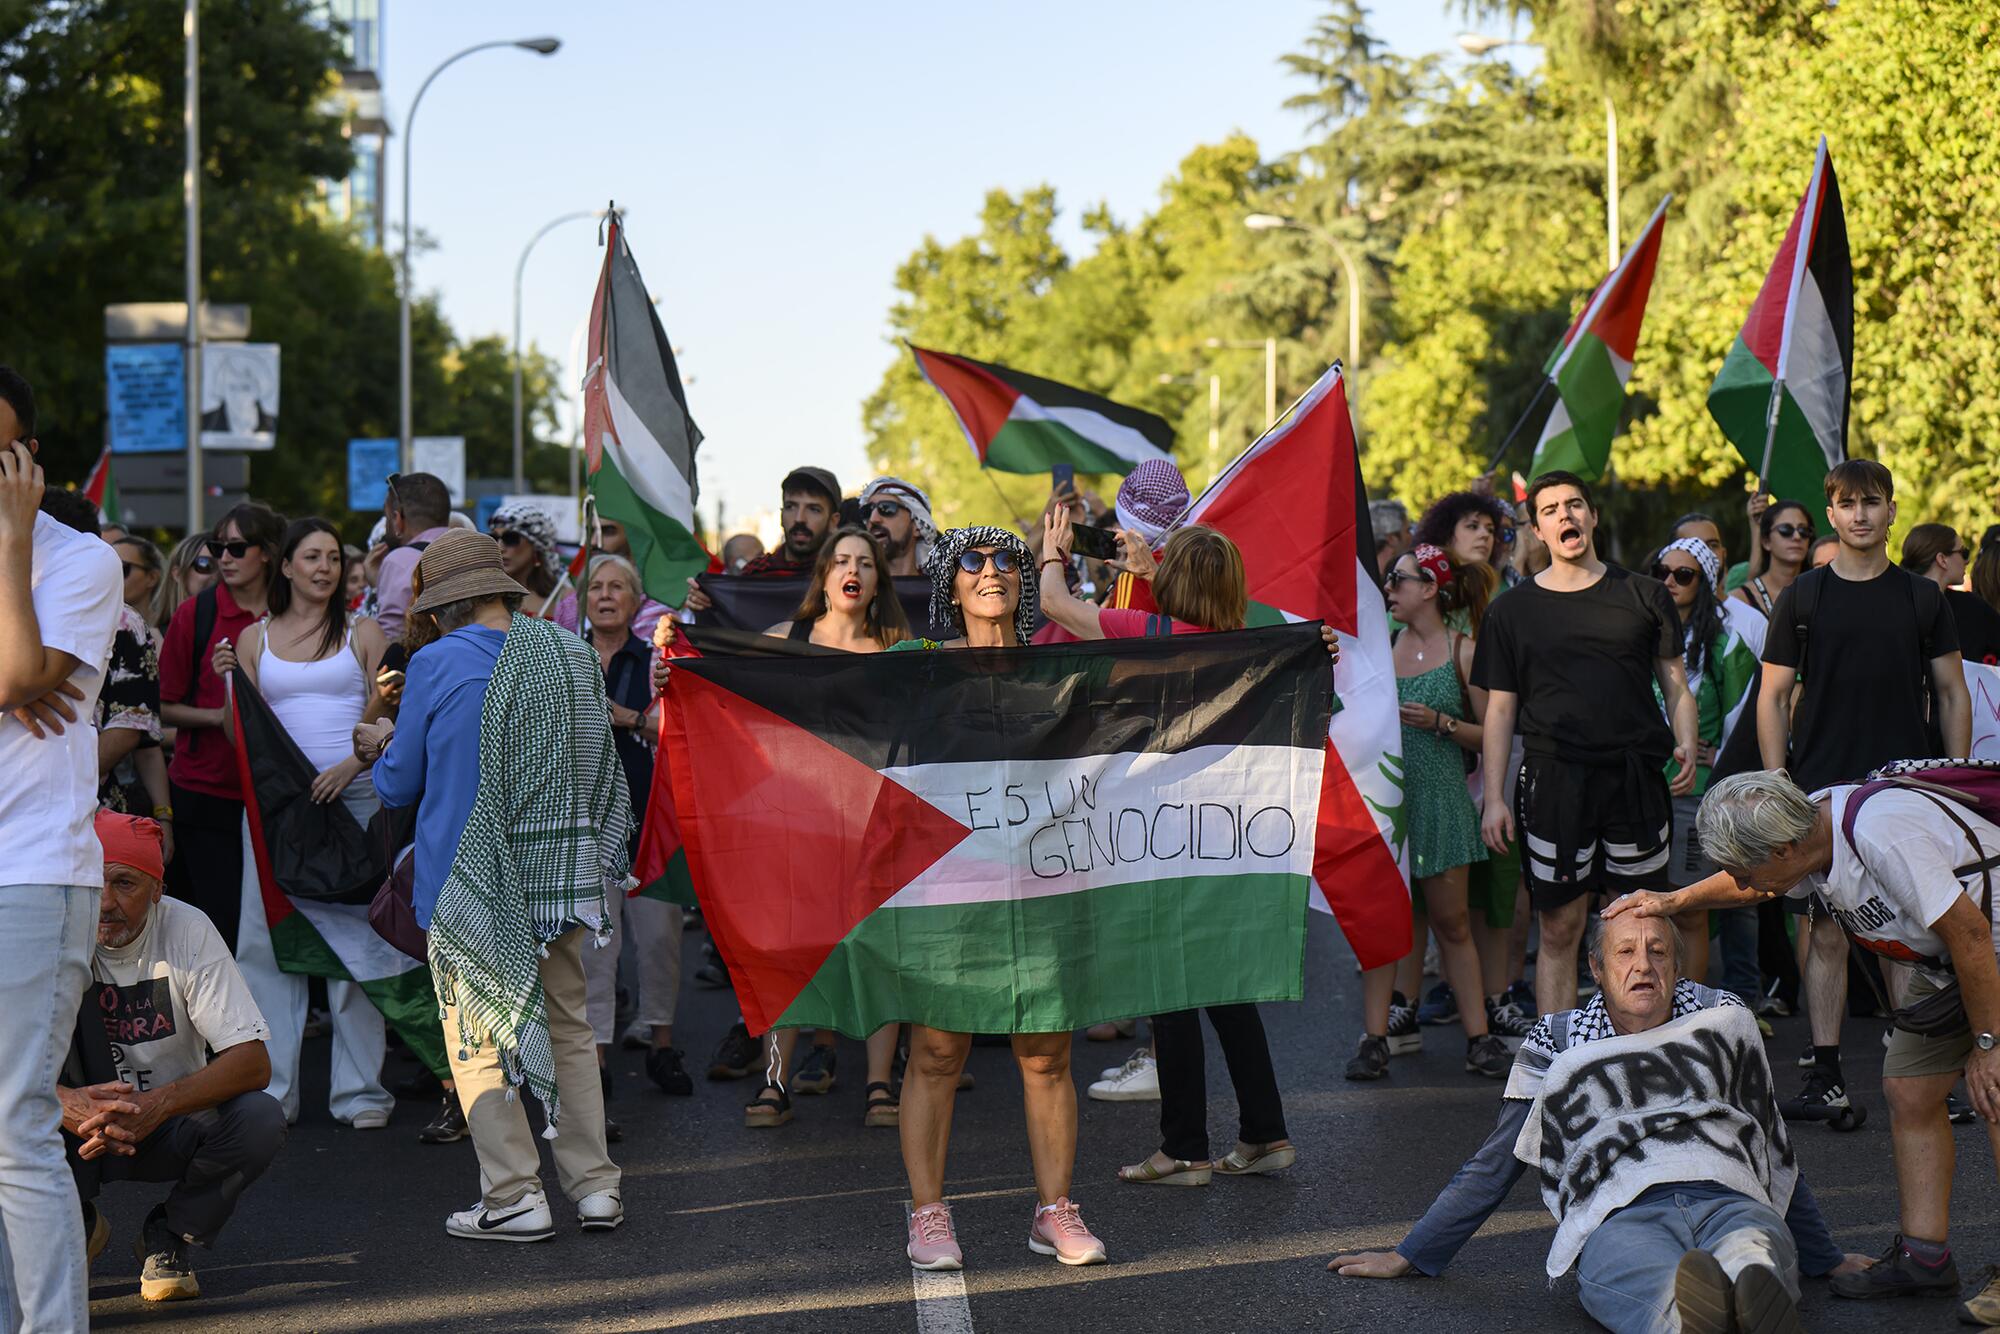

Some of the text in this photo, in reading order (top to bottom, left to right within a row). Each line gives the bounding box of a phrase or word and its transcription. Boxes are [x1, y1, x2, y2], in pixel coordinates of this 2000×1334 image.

[966, 768, 1105, 831] ES UN
[1029, 803, 1296, 879] GENOCIDIO
[103, 1013, 172, 1041] ERRA
